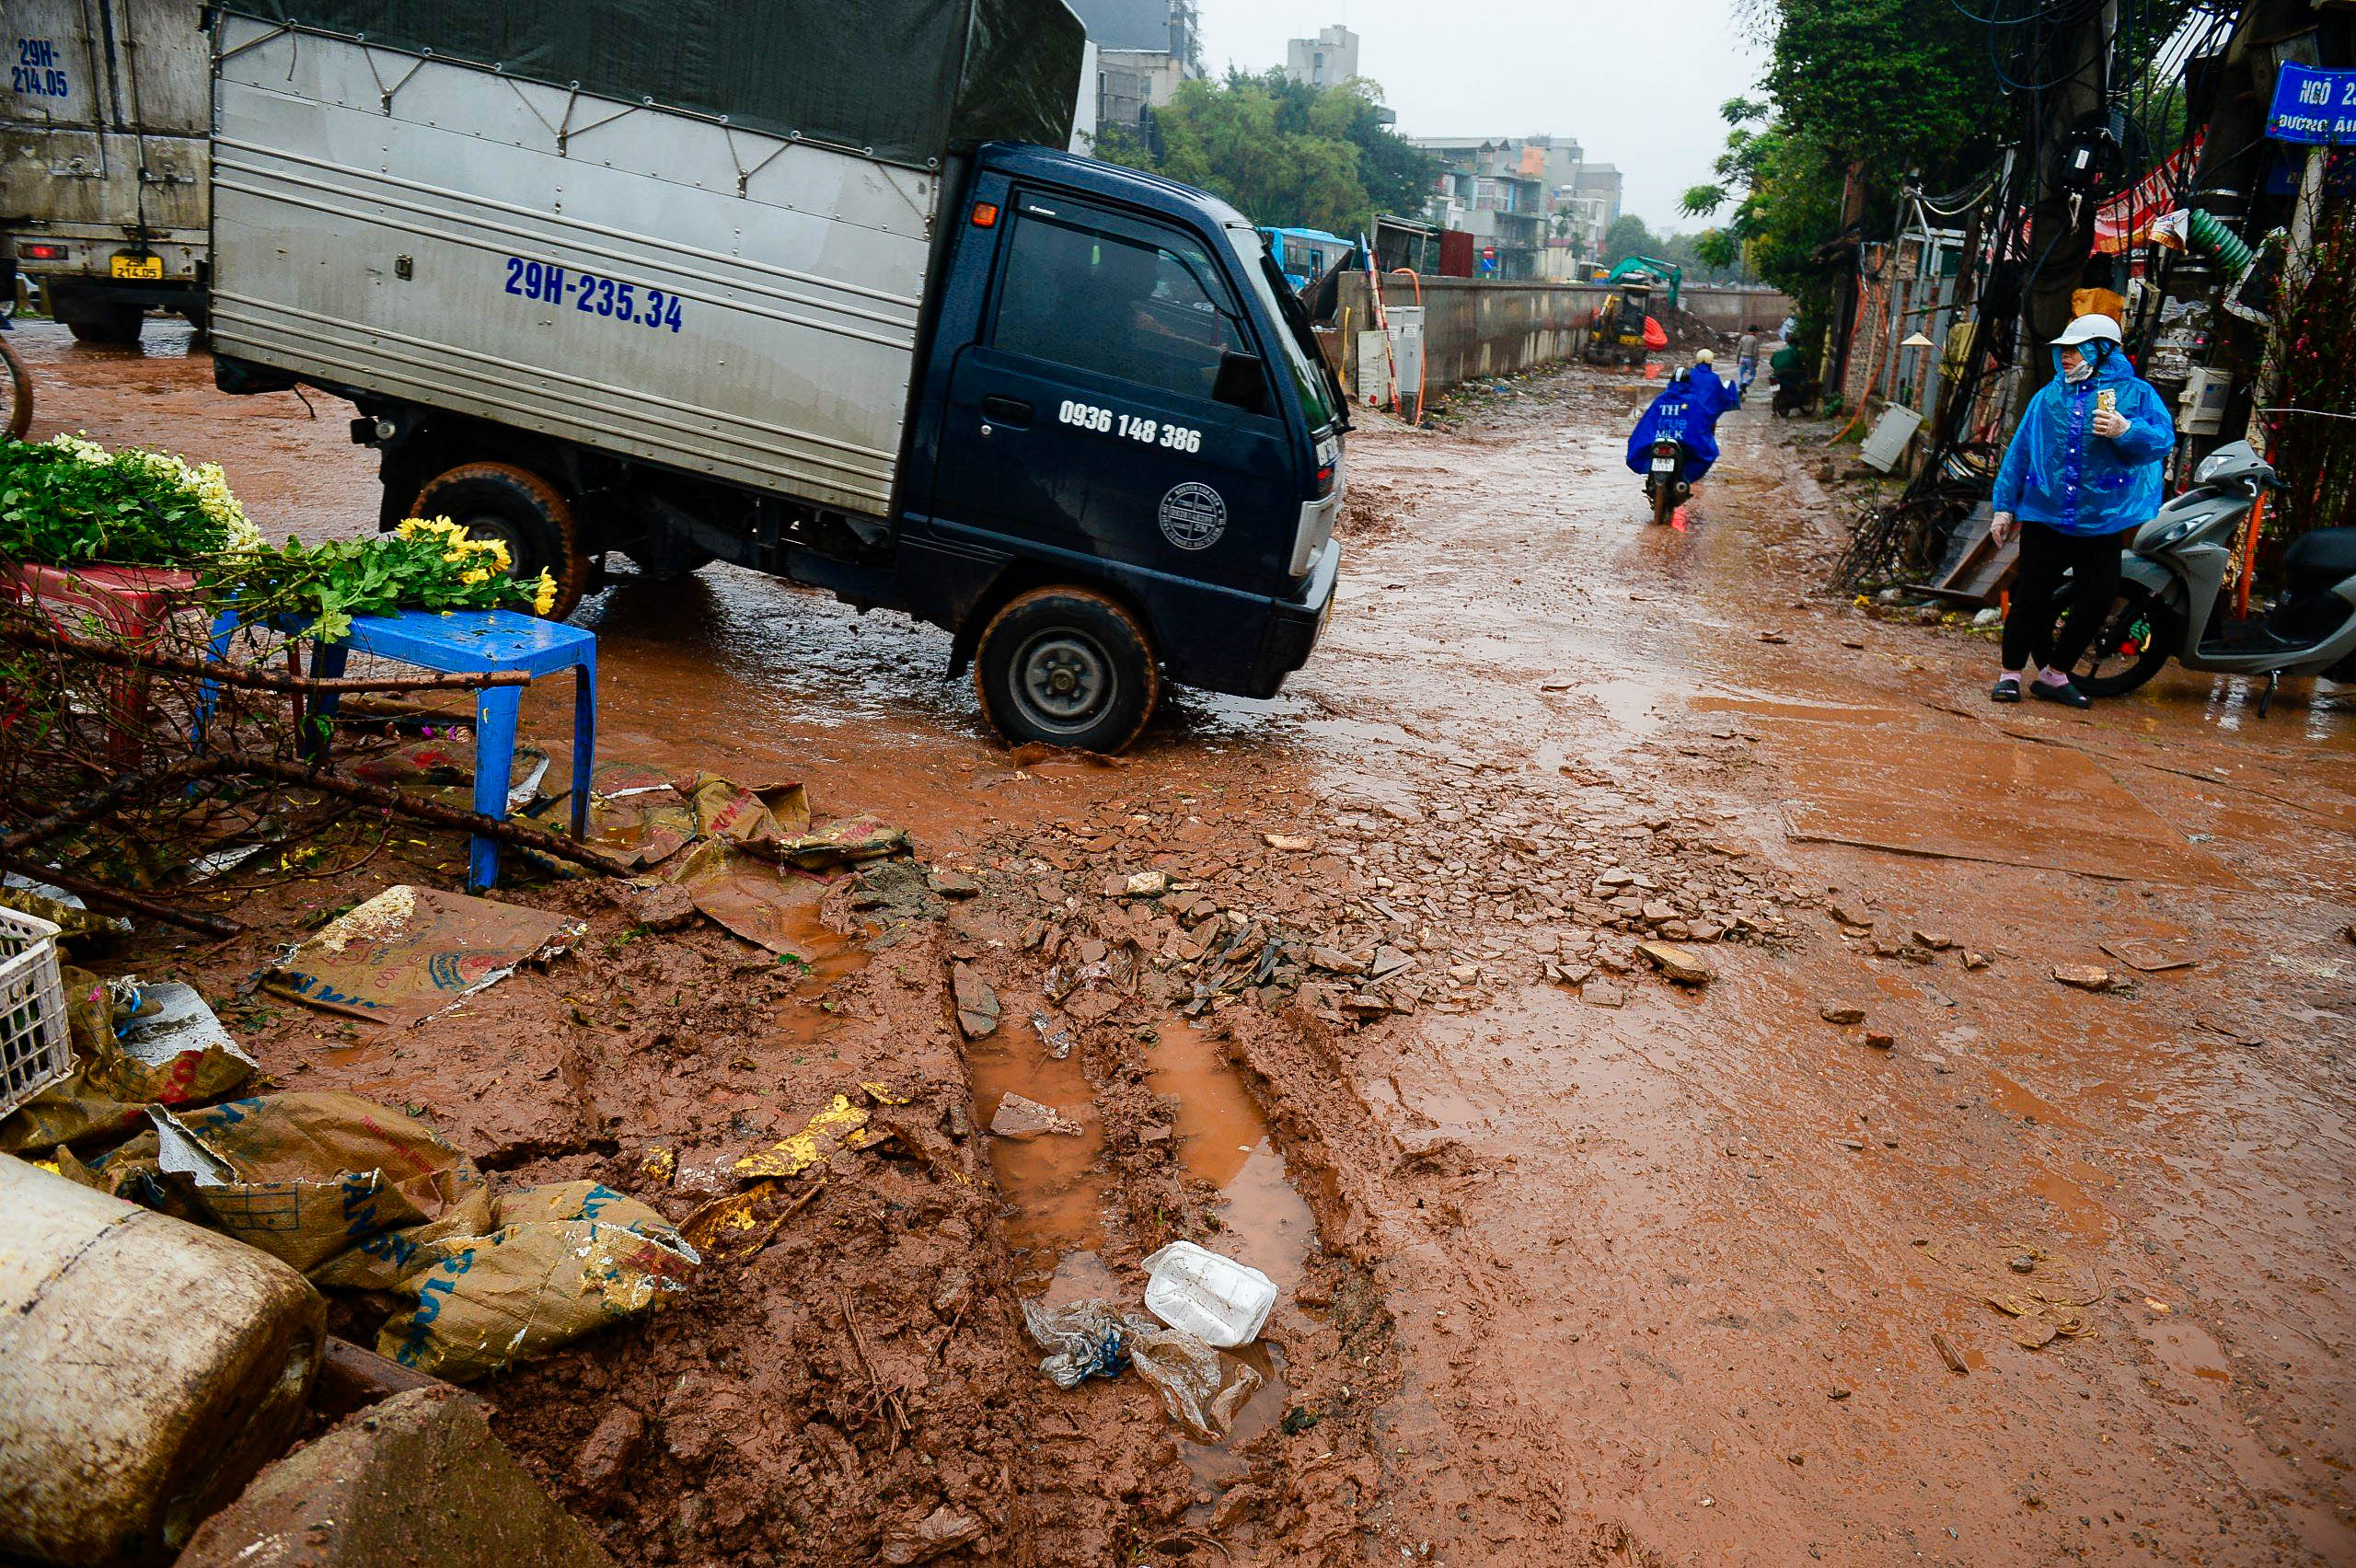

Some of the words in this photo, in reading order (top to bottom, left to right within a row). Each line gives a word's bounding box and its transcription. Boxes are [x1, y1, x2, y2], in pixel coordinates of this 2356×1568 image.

[18, 38, 60, 67] 29H-
[11, 65, 68, 98] 214.05
[505, 257, 682, 334] 29H-235.34
[1657, 419, 1688, 430] true
[1659, 405, 1680, 416] TH
[1059, 400, 1113, 432] 0936
[1118, 414, 1157, 444] 148
[1160, 423, 1202, 454] 386
[1655, 430, 1683, 440] MILK
